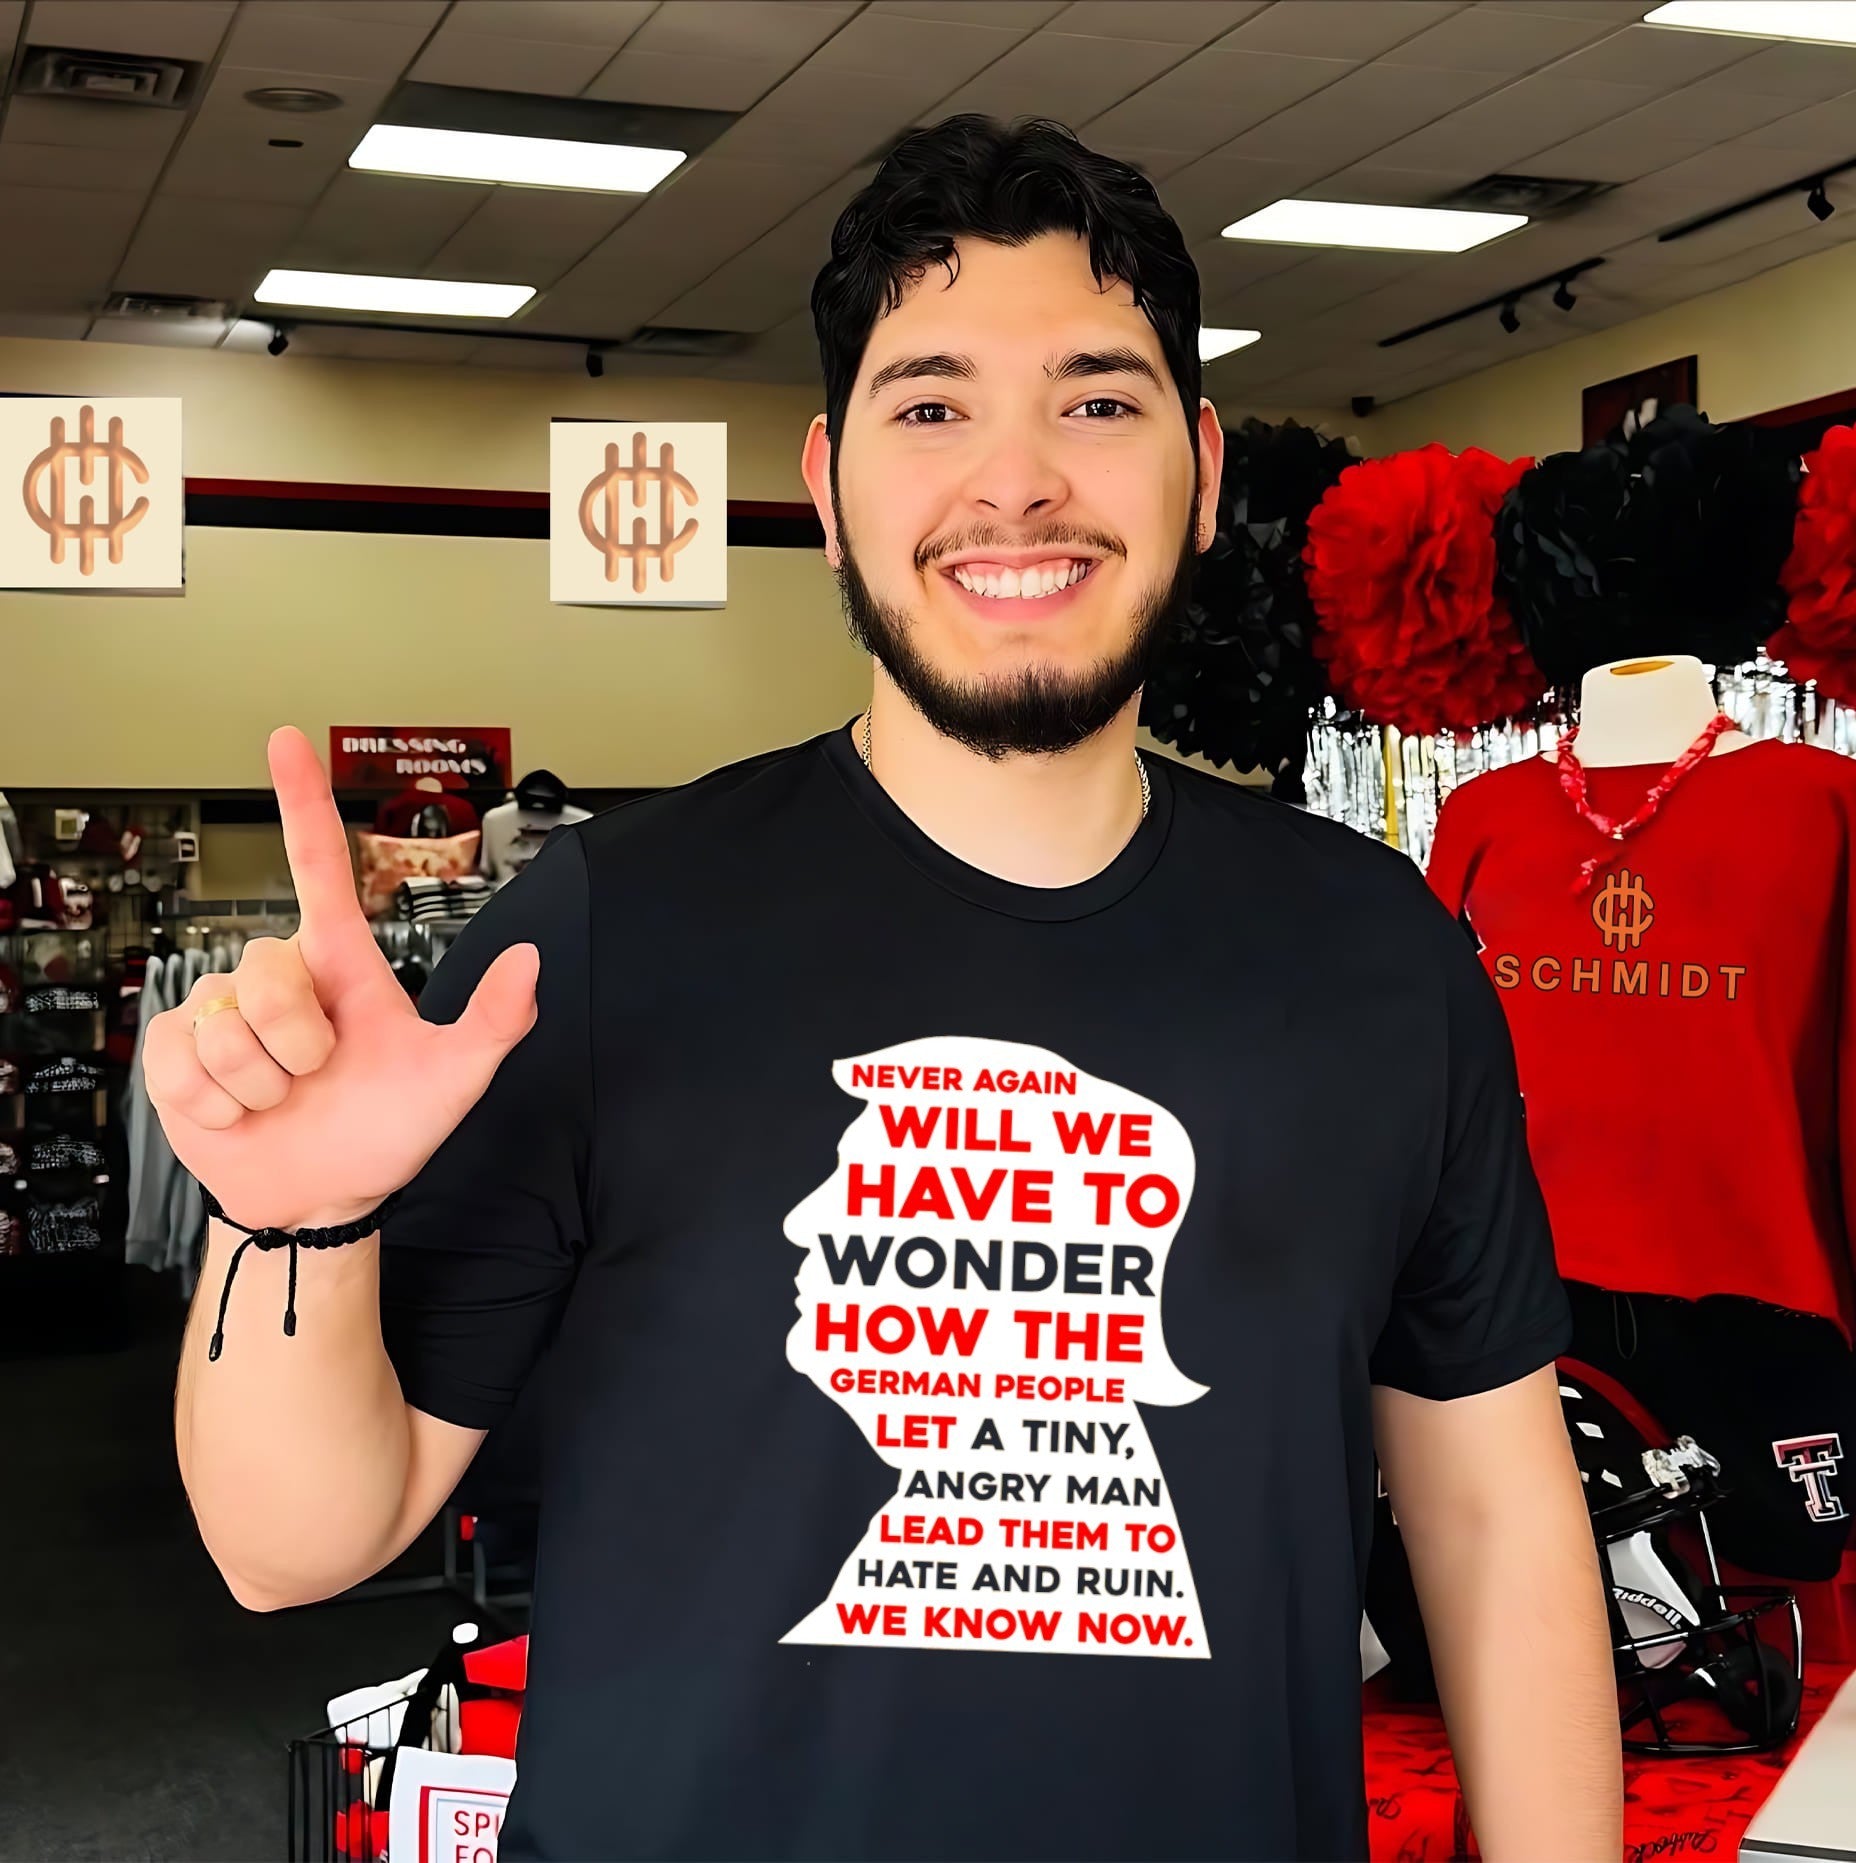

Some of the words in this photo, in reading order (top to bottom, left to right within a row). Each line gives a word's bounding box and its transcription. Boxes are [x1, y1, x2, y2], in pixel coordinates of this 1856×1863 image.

[341, 737, 467, 754] DRESSING
[1494, 953, 1747, 1001] SCHMIDT
[851, 1063, 963, 1091] NEVER
[972, 1068, 1077, 1096] AGAIN
[878, 1104, 1032, 1153] WILL
[1052, 1110, 1153, 1158] WE
[846, 1163, 1054, 1224] HAVE
[1083, 1171, 1181, 1229] TO
[818, 1233, 1156, 1297] WONDER
[815, 1302, 990, 1357] HOW
[1013, 1309, 1145, 1364] THE
[830, 1367, 982, 1398] GERMAN
[994, 1373, 1125, 1404] PEOPLE
[876, 1413, 958, 1449] LET
[970, 1417, 1005, 1451] A
[1022, 1419, 1135, 1460] TINY,
[904, 1469, 1052, 1503] ANGRY
[1066, 1475, 1161, 1507] MAN
[880, 1514, 984, 1546] LEAD
[998, 1518, 1109, 1551] THEM
[1124, 1523, 1176, 1554] TO
[858, 1558, 958, 1590] HATE
[971, 1563, 1061, 1593] AND
[1077, 1566, 1184, 1599] RUIN.
[835, 1602, 908, 1637] WE
[923, 1606, 1063, 1642] KNOW
[1077, 1611, 1193, 1647] NOW.
